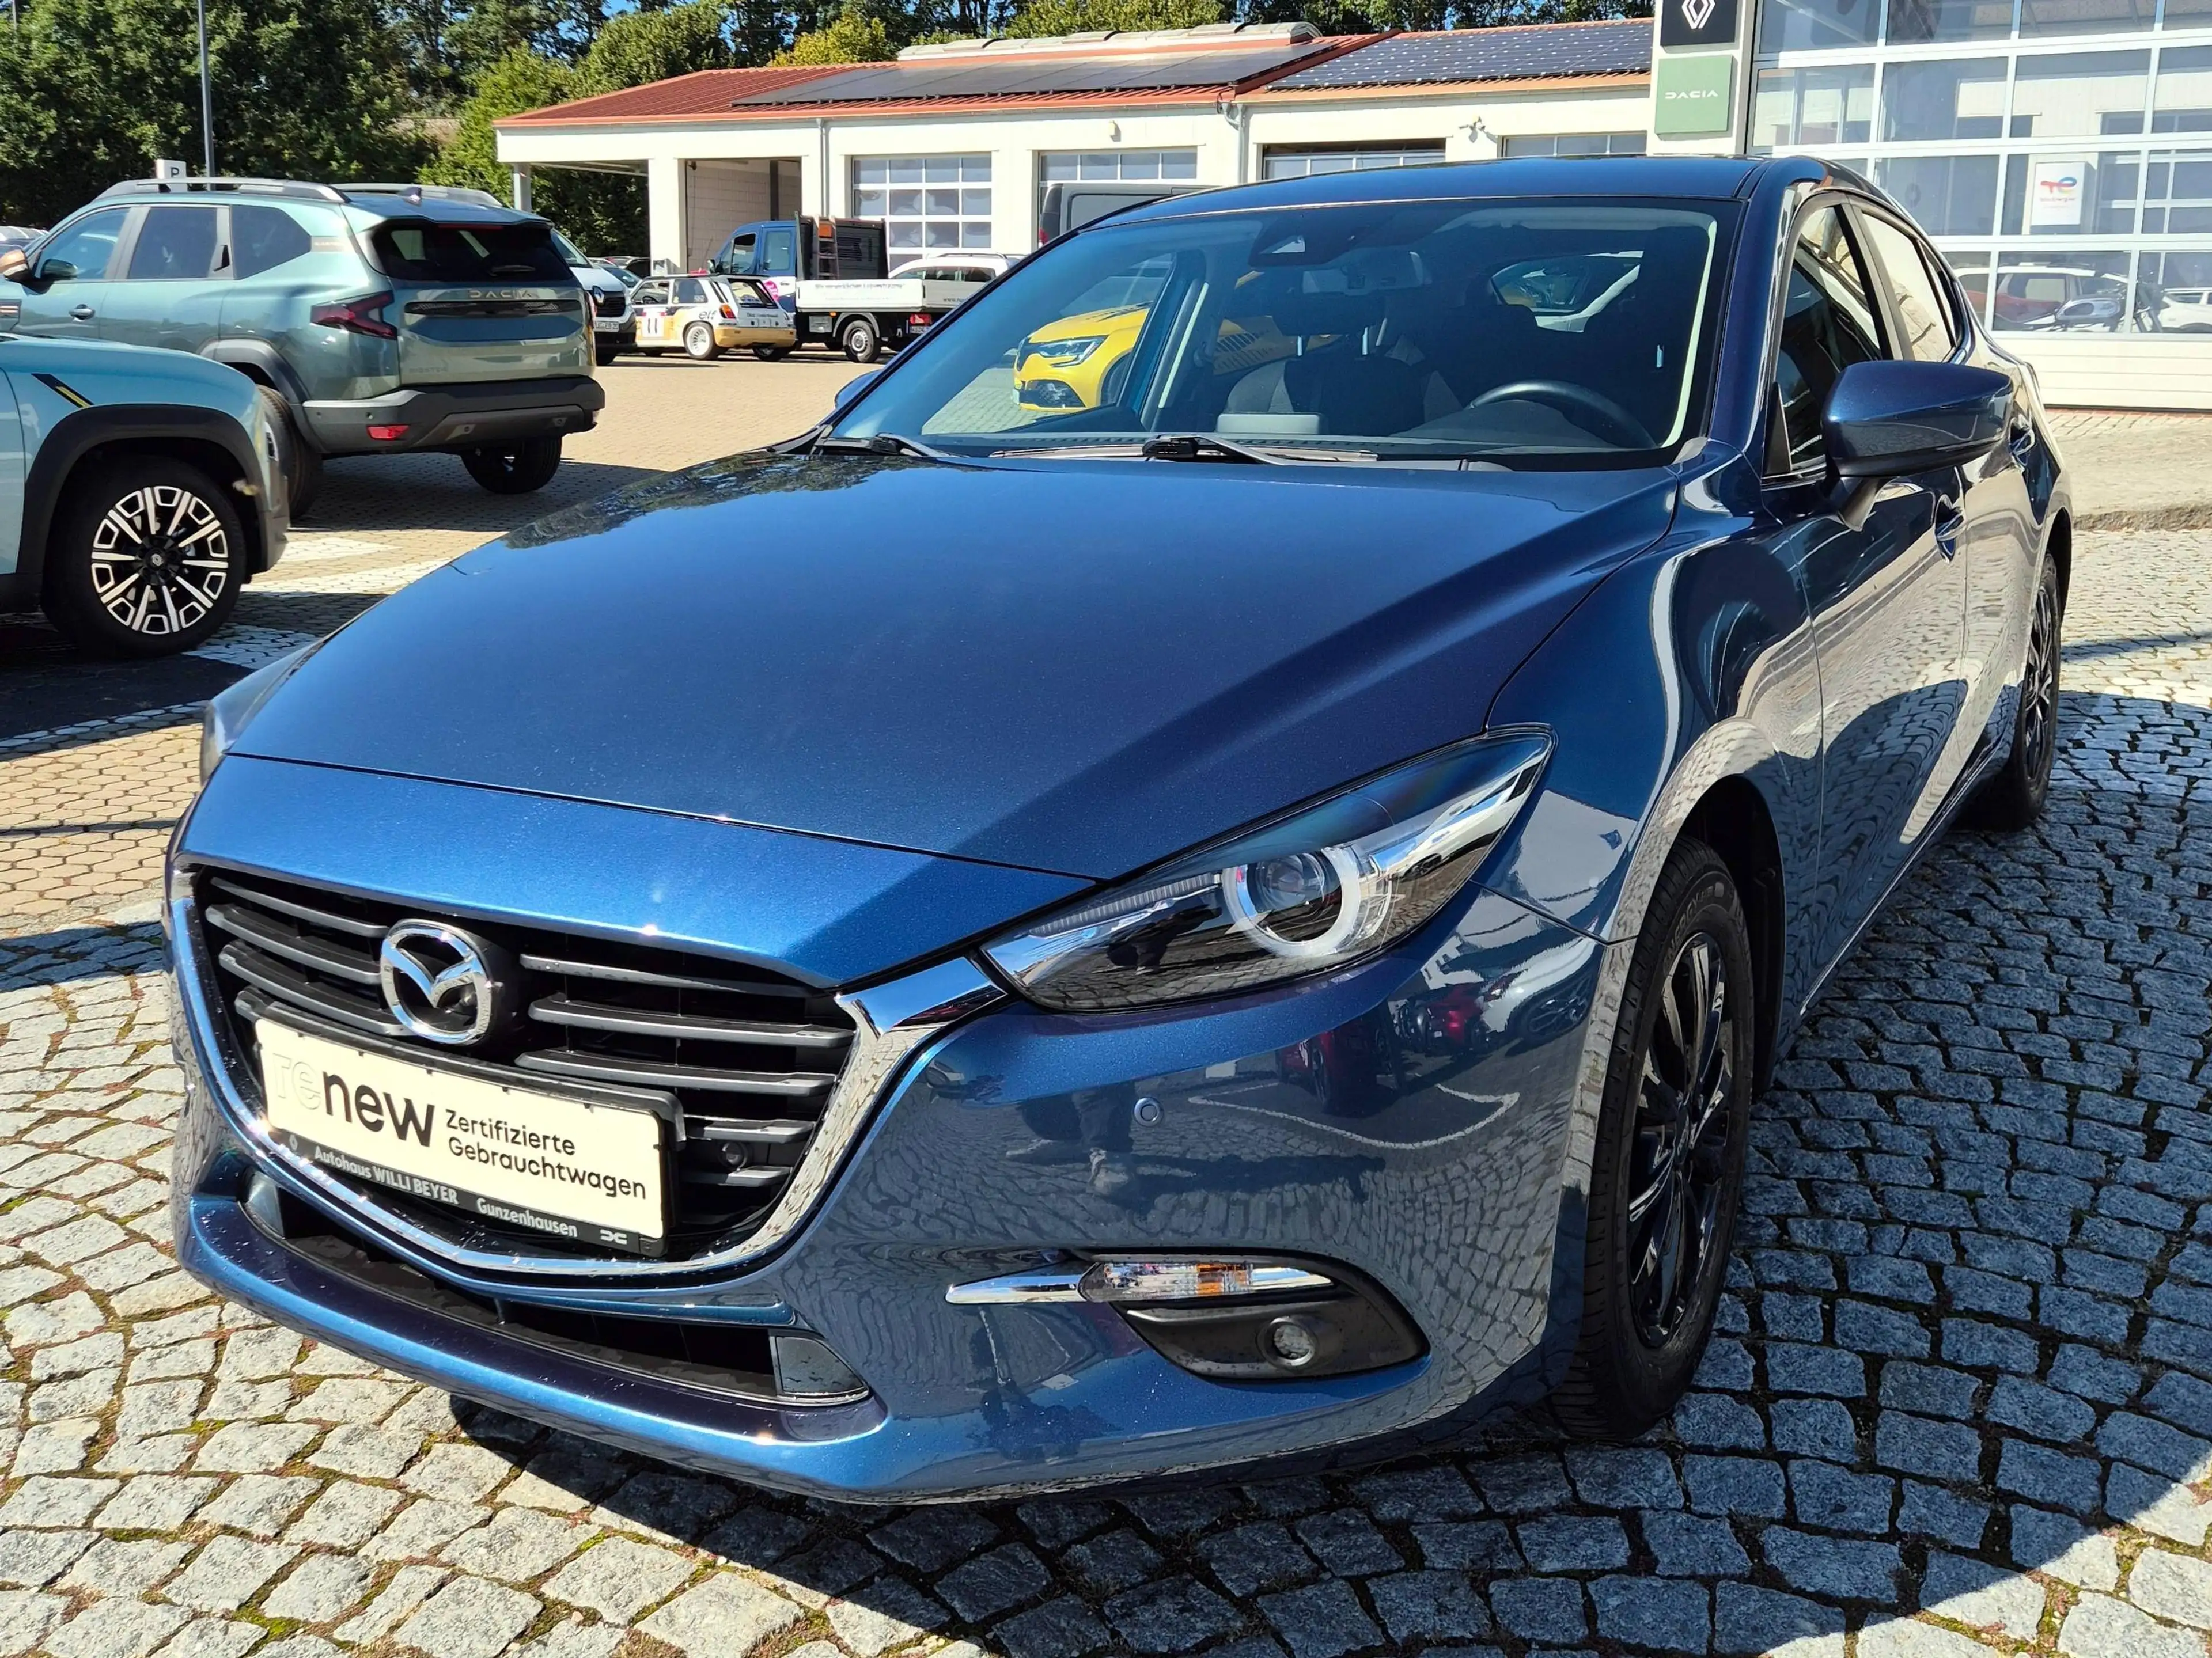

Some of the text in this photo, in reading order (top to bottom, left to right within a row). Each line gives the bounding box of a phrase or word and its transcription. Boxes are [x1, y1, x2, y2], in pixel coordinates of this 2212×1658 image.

[1665, 90, 1719, 100] DACIA
[170, 166, 180, 177] P
[469, 290, 532, 298] DACIA
[698, 310, 717, 320] elf
[647, 318, 658, 334] 11
[273, 1053, 435, 1148] renew
[445, 1109, 575, 1156] Zertifizierte
[449, 1136, 646, 1200] Gebrauchtwagen
[315, 1145, 578, 1238] Autohaus WILLI BEYER Gunzenhausen
